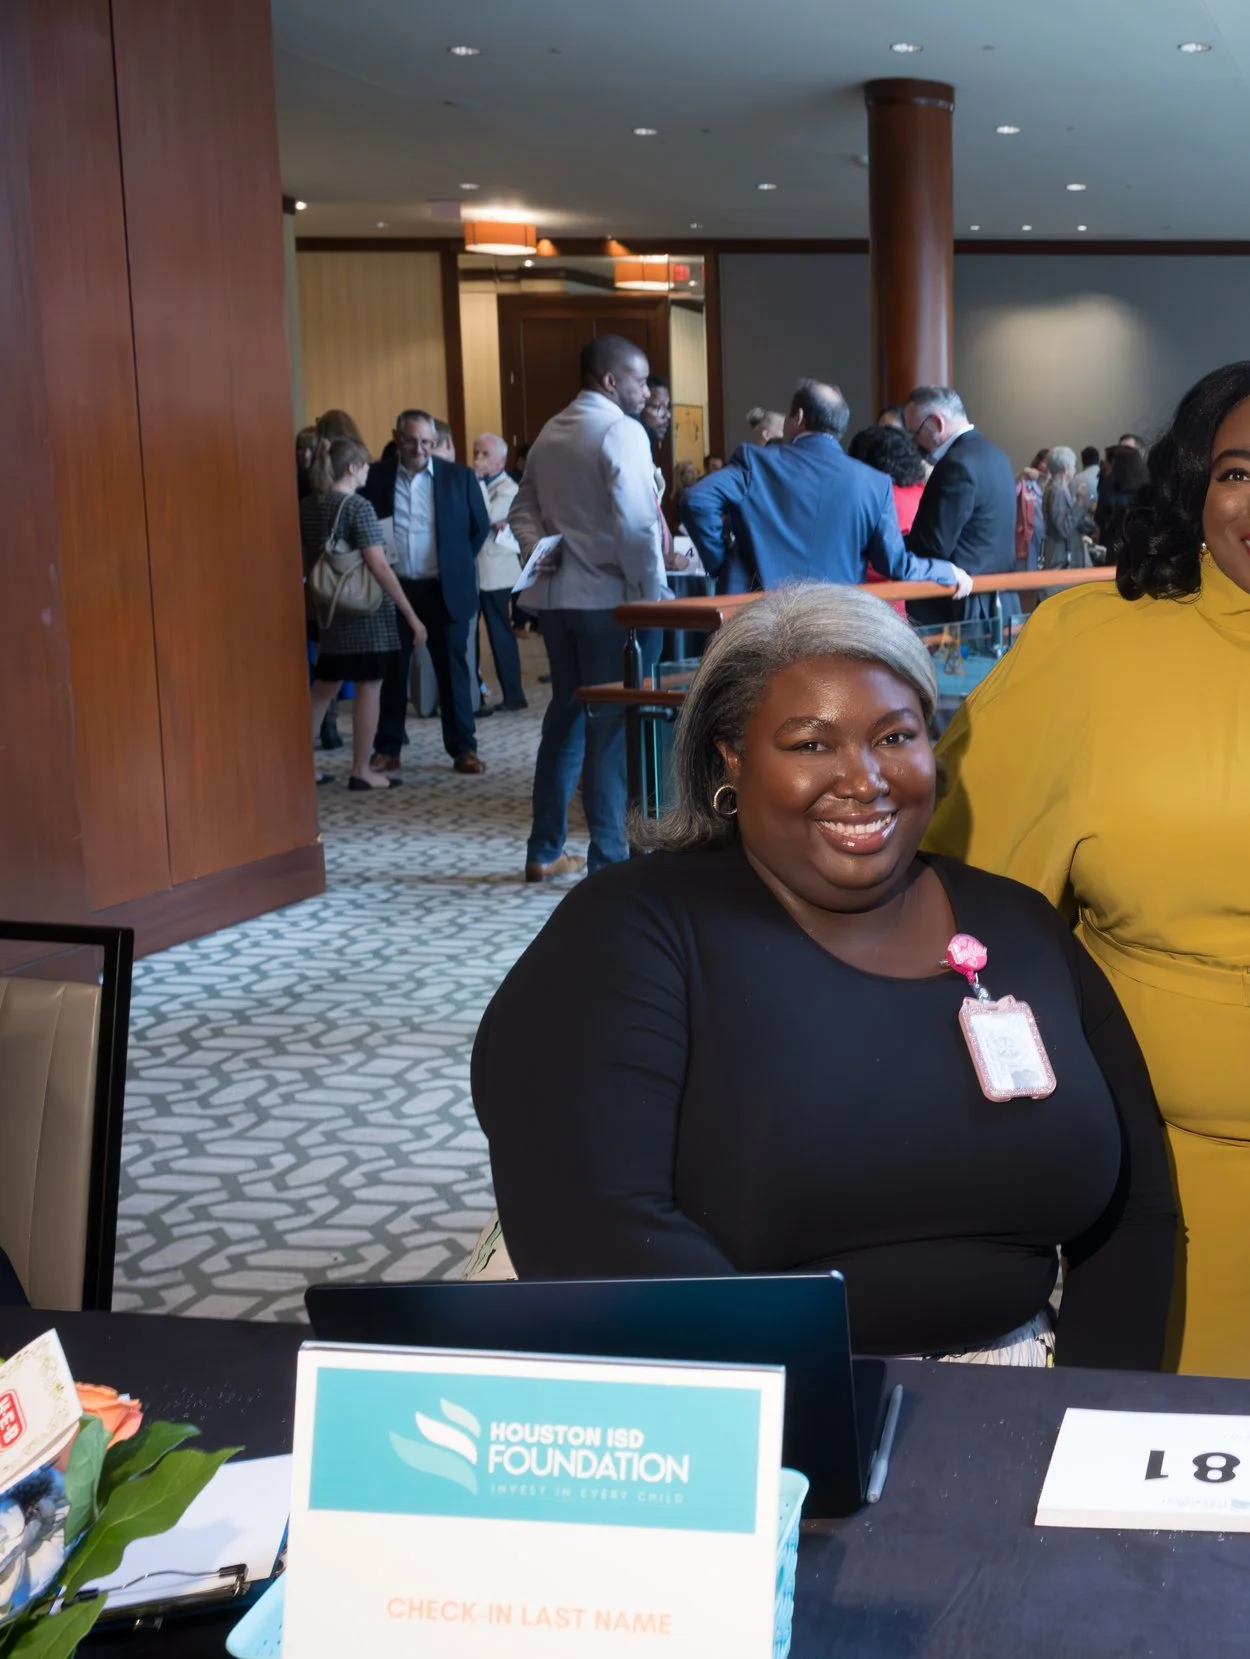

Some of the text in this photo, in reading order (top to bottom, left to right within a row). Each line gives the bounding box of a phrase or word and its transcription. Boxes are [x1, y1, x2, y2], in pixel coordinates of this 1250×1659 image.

[489, 1421, 645, 1449] HOUSTON ISD
[488, 1444, 690, 1485] FOUNDATION
[490, 1484, 684, 1505] INVEST IN EVERY CHILD
[387, 1597, 672, 1635] CHECK-IN LAST NAME
